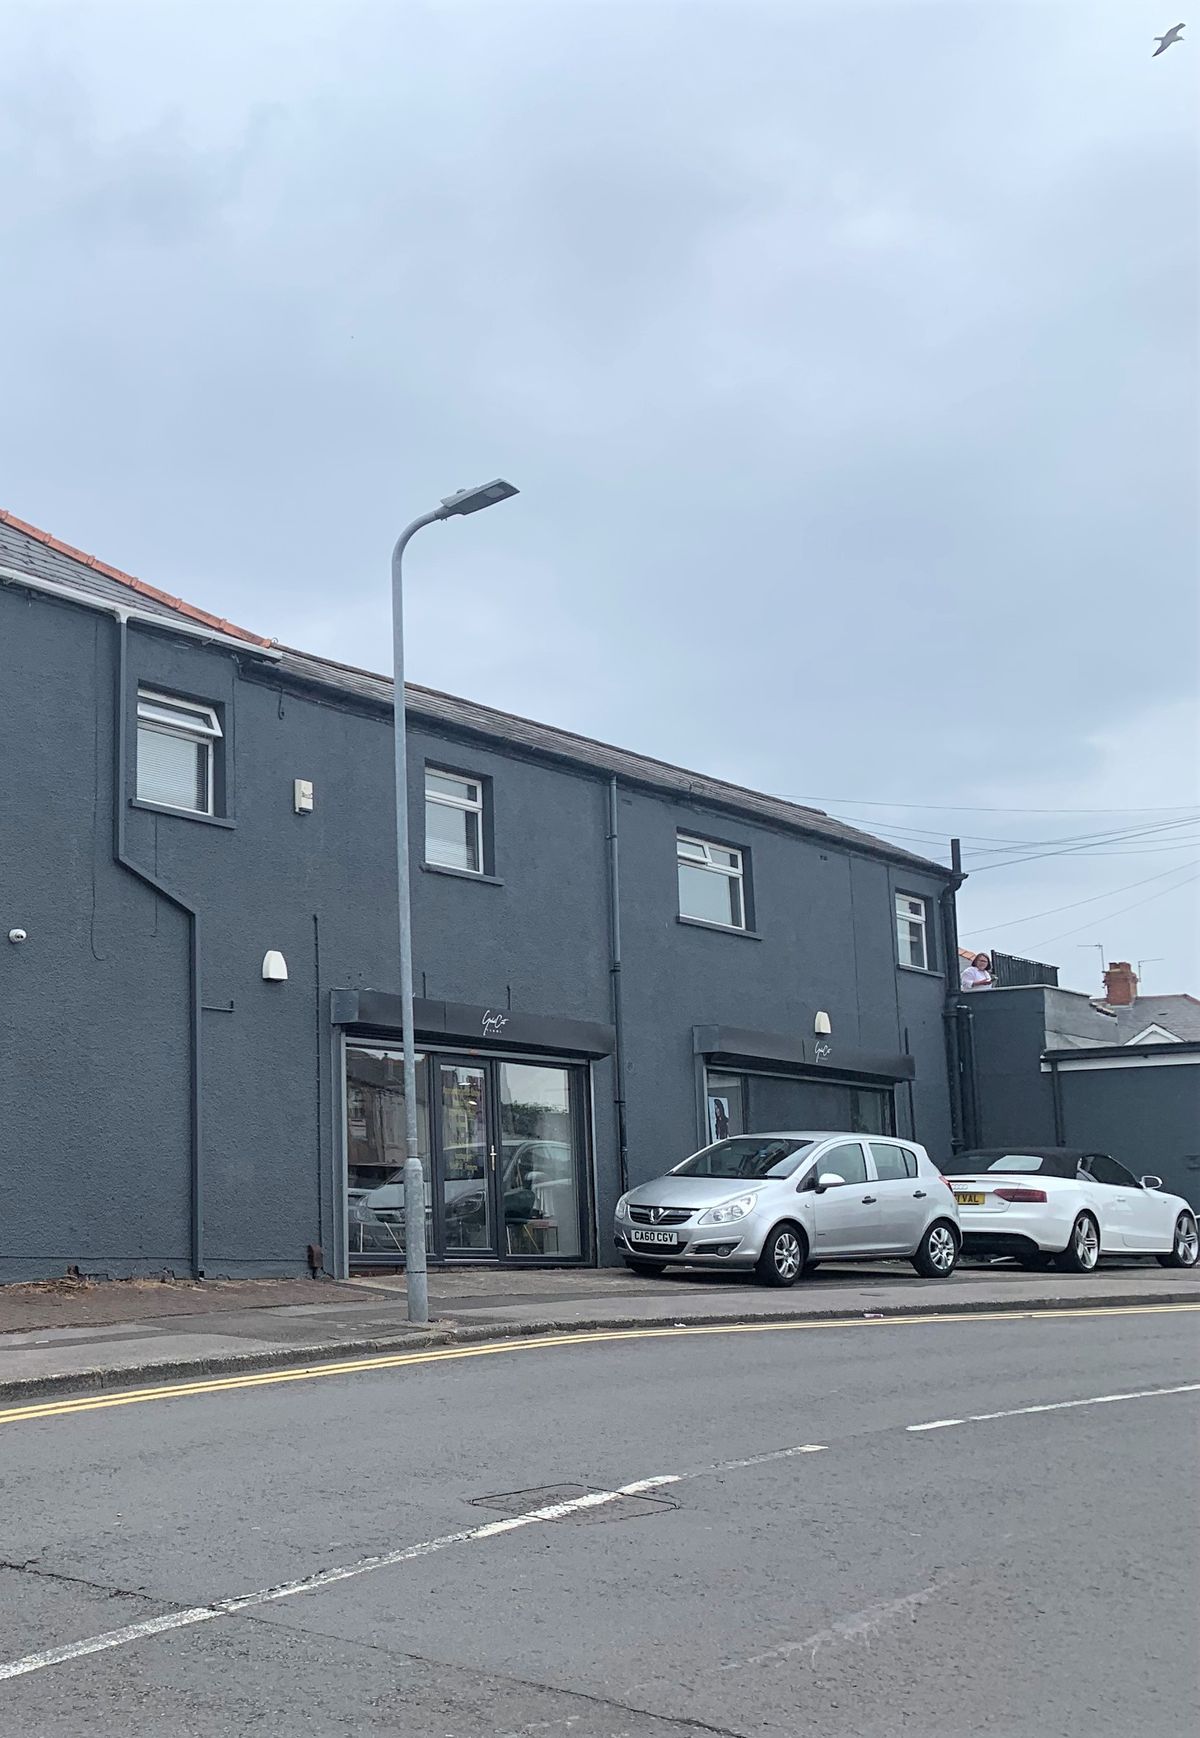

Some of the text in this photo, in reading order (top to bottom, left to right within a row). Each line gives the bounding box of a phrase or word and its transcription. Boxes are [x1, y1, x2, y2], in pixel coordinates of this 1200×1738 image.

[962, 1194, 980, 1203] VAL
[634, 1231, 674, 1242] CA60 CGV
